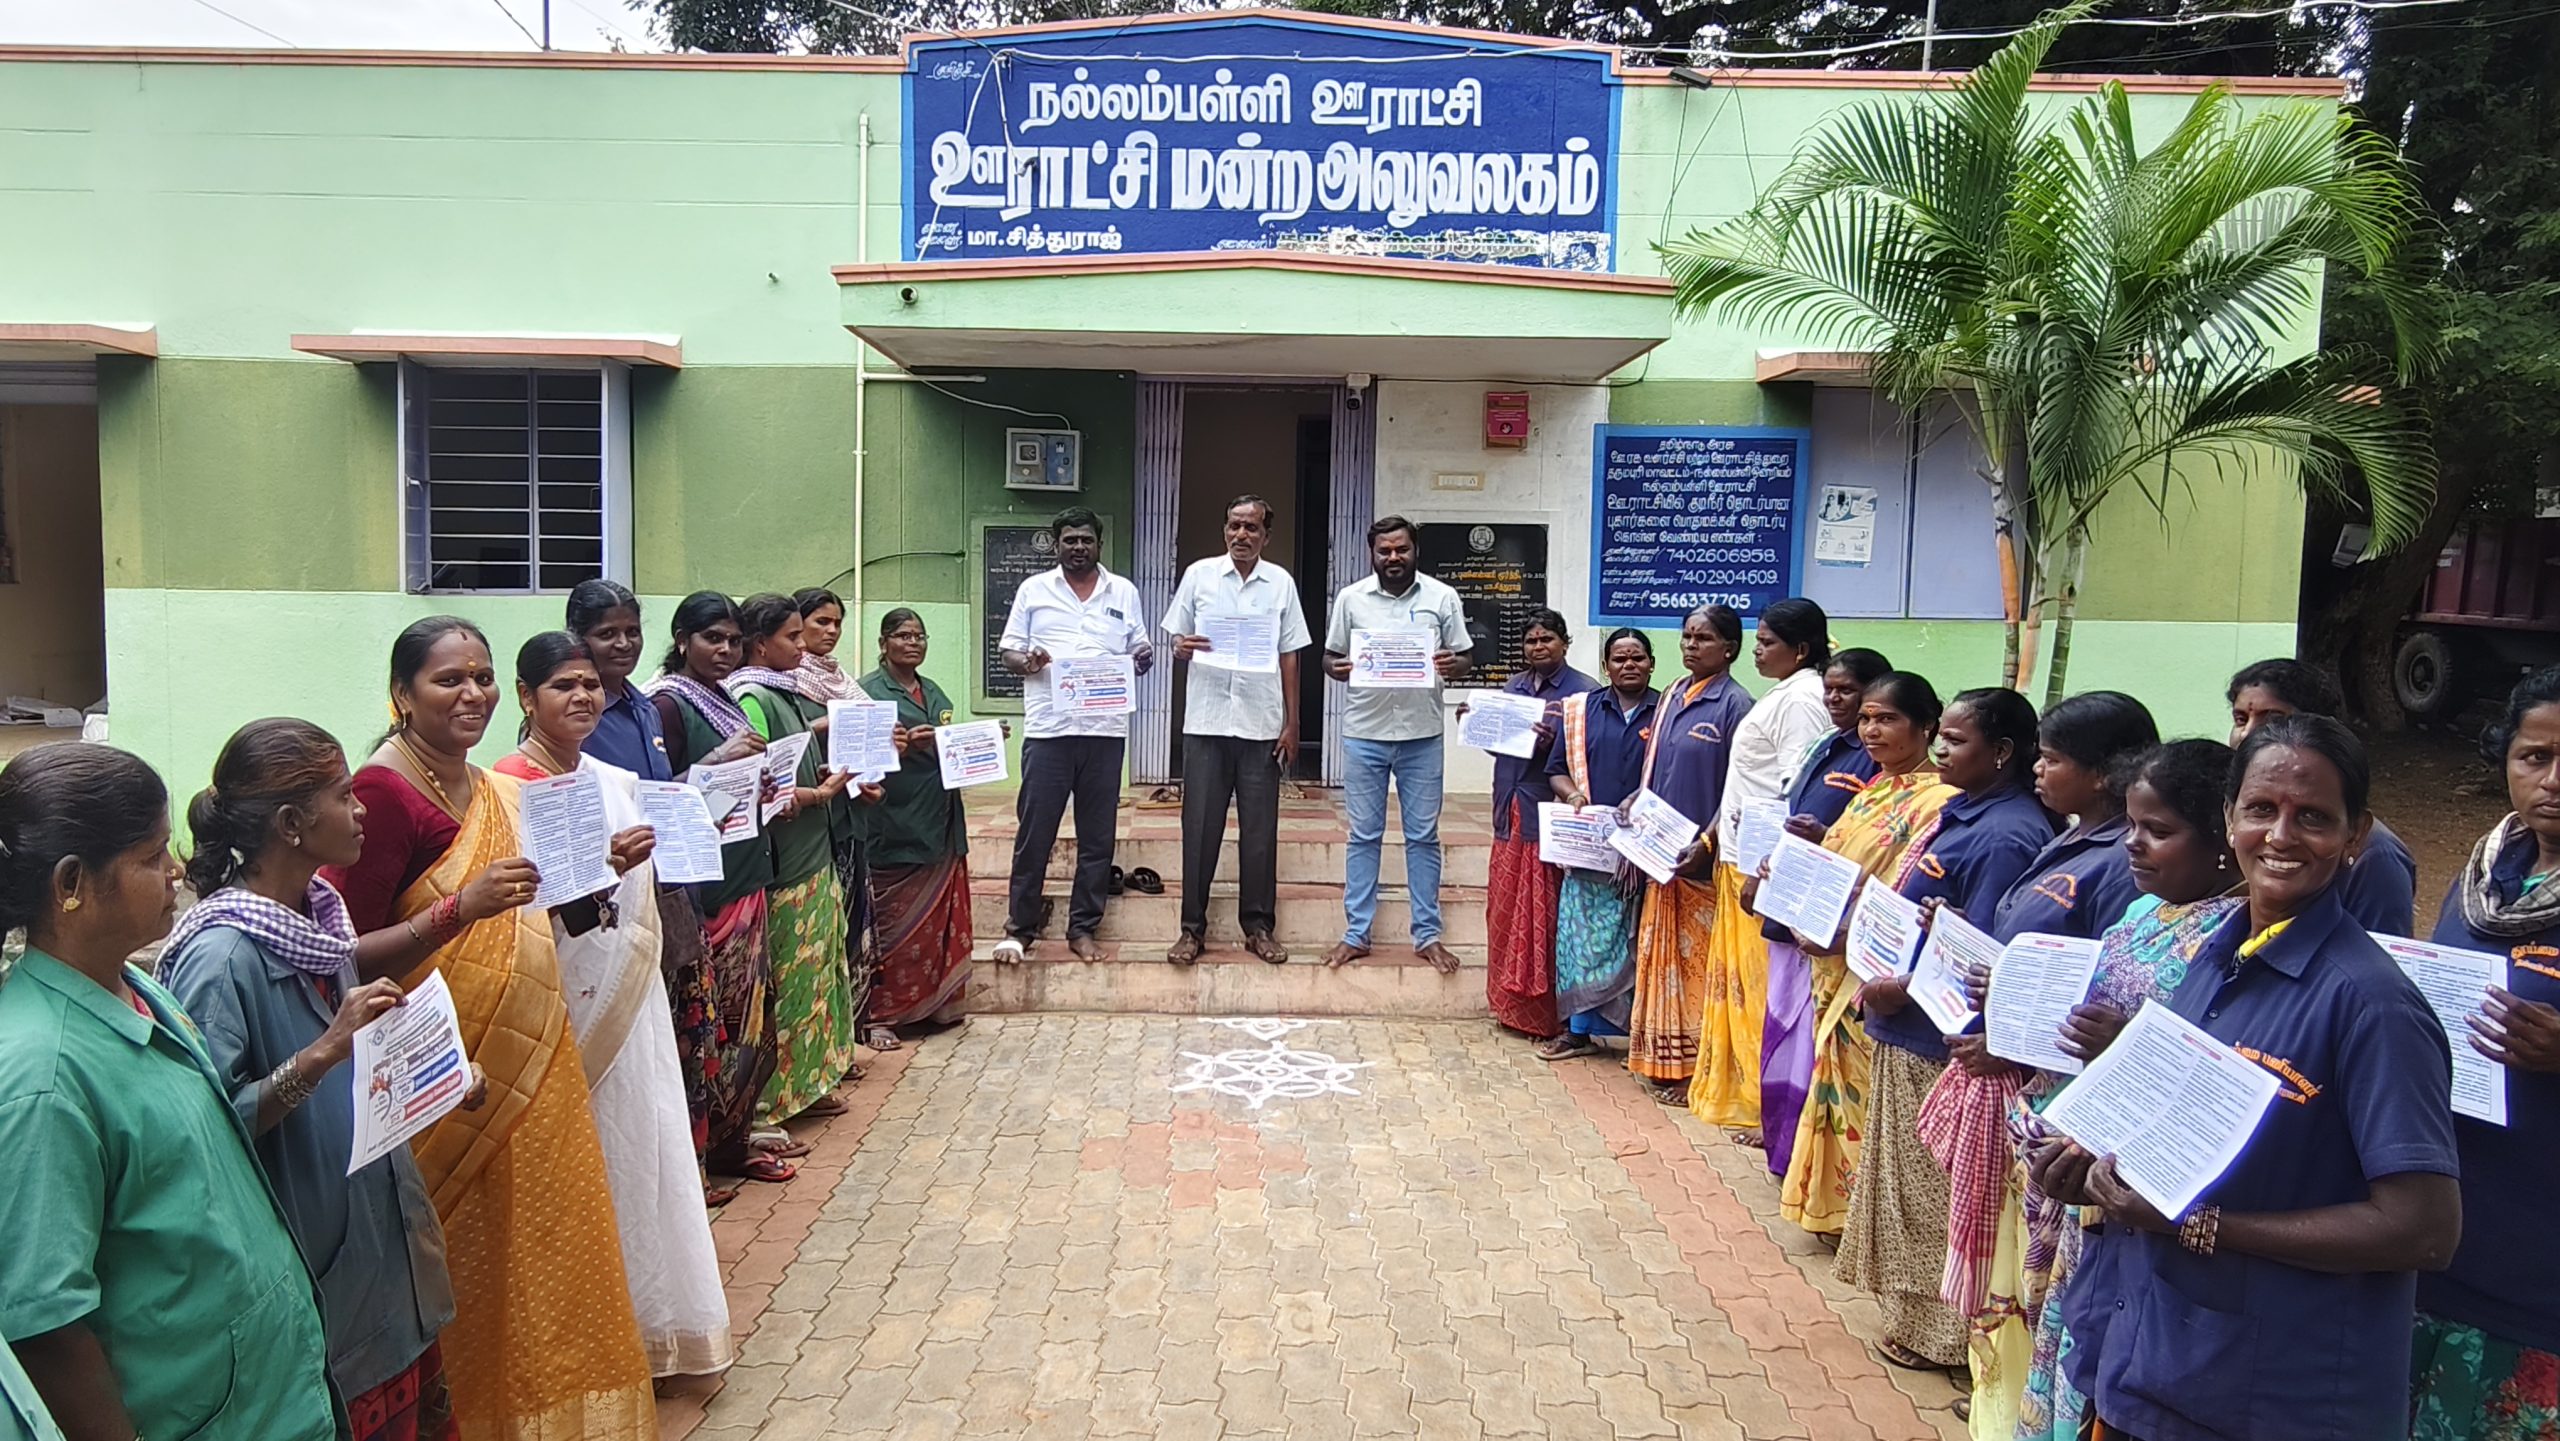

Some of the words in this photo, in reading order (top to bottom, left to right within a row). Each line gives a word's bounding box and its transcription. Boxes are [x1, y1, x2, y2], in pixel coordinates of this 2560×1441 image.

[1019, 67, 1291, 134] நல்லம்பள்ளி
[1310, 78, 1482, 135] ஊராட்சி
[929, 130, 1159, 221] ஊராட்சி
[1171, 132, 1313, 226] மன்ற
[1316, 137, 1599, 228] அலுவலகம்
[967, 223, 1122, 253] மா.சித்துராஜ்
[1657, 438, 1705, 452] தமிழ்நாடு
[1706, 439, 1736, 451] அரசு
[1610, 450, 1642, 465] ஊரக
[1643, 451, 1686, 465] வளர்ச்சி
[1711, 450, 1790, 466] ஊராட்சித்துறை
[1606, 466, 1645, 481] தருமபுரி
[1642, 478, 1707, 493] நல்லம்பள்ளி
[1708, 478, 1757, 494] ஊராட்சி
[1607, 492, 1685, 512] ஊராட்சியில்
[1687, 491, 1725, 513] குடிநீர்
[1726, 493, 1791, 513] தொடர்பான
[1607, 513, 1670, 531] புகார்களை
[1672, 513, 1738, 531] பொதுமக்கள்
[1740, 513, 1787, 531] தொடர்பு
[1659, 530, 1709, 547] வேண்டிய
